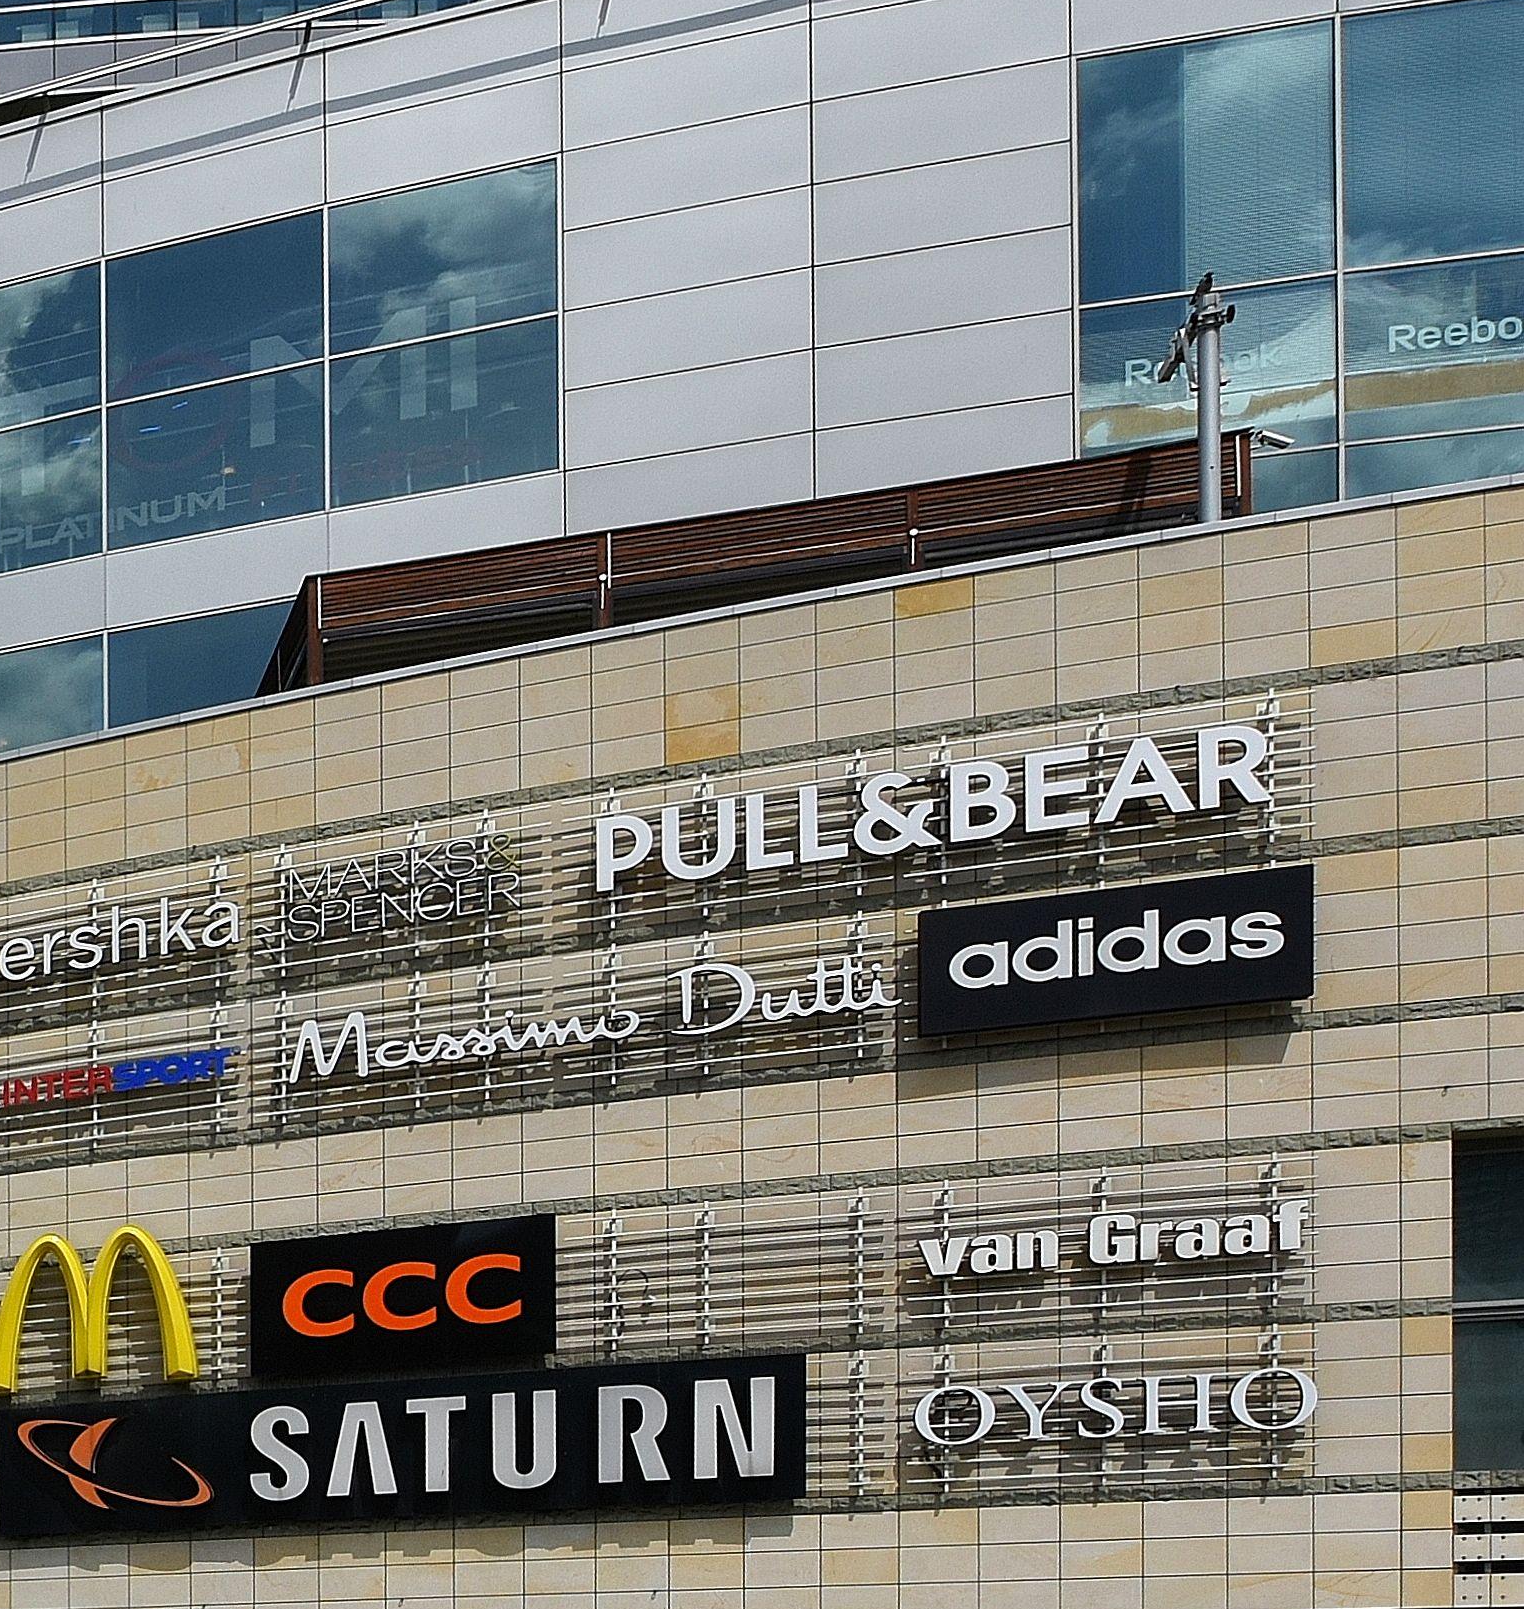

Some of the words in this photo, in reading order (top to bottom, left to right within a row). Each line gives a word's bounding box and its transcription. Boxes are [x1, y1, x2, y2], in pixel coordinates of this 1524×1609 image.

[594, 723, 1270, 893] PULL&BEAR
[287, 872, 521, 947] SPENCER
[947, 903, 1286, 989] adidas
[290, 1003, 640, 1085] Massimo
[671, 958, 903, 1035] Dutti
[3, 1047, 230, 1109] INTERSPORT
[918, 1226, 1060, 1277] van
[1089, 1196, 1309, 1265] Graaf
[282, 1252, 523, 1338] CCC
[250, 1376, 775, 1501] SATURN
[914, 1367, 1319, 1444] OYSHO
